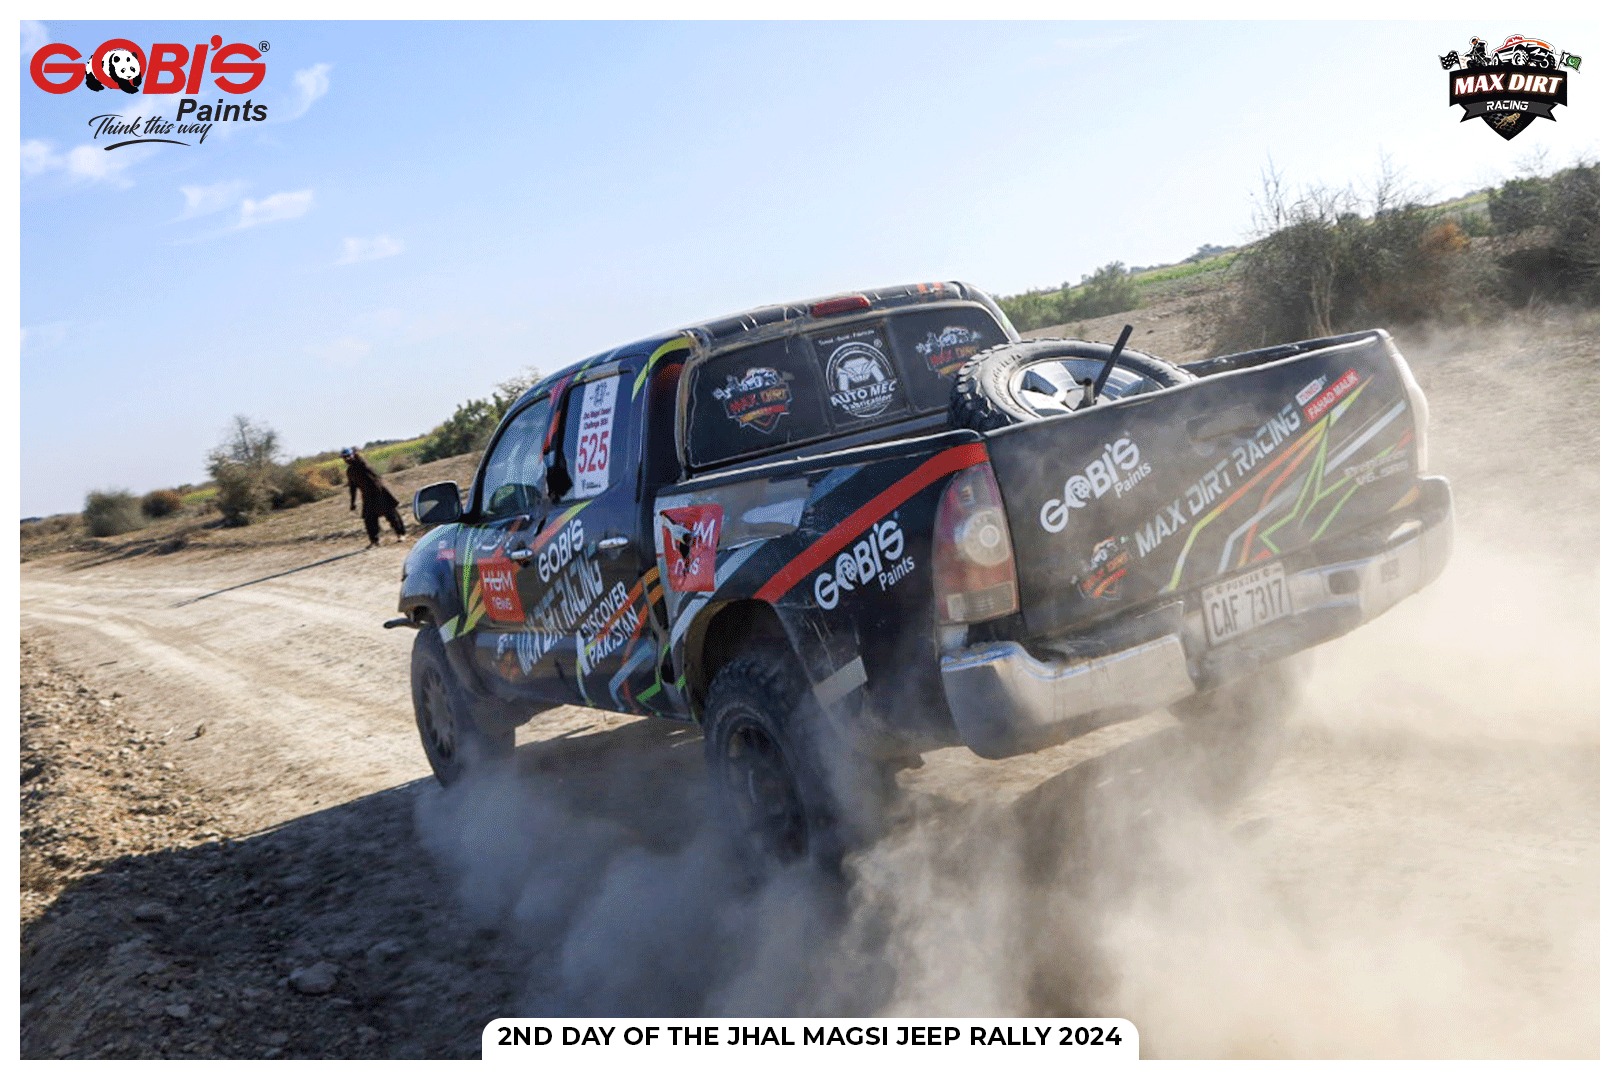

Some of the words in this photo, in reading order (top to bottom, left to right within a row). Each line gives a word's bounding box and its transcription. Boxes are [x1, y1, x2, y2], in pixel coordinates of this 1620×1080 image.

[830, 388, 868, 407] AUTO
[870, 378, 897, 397] MEC
[578, 431, 609, 474] 525
[1114, 462, 1152, 498] Paints
[1135, 499, 1187, 558] MAX
[1185, 459, 1231, 516] DIRT
[1232, 403, 1300, 476] RACING
[1040, 438, 1140, 533] GOBI'S
[482, 569, 514, 593] HUM
[538, 519, 584, 583] GOBI'S
[814, 520, 904, 610] GOBI'S
[879, 556, 915, 591] Paints
[581, 580, 630, 642] DISCOVER
[588, 605, 640, 668] PAKISTAN
[1210, 594, 1239, 637] CAF
[1245, 577, 1283, 625] 7317
